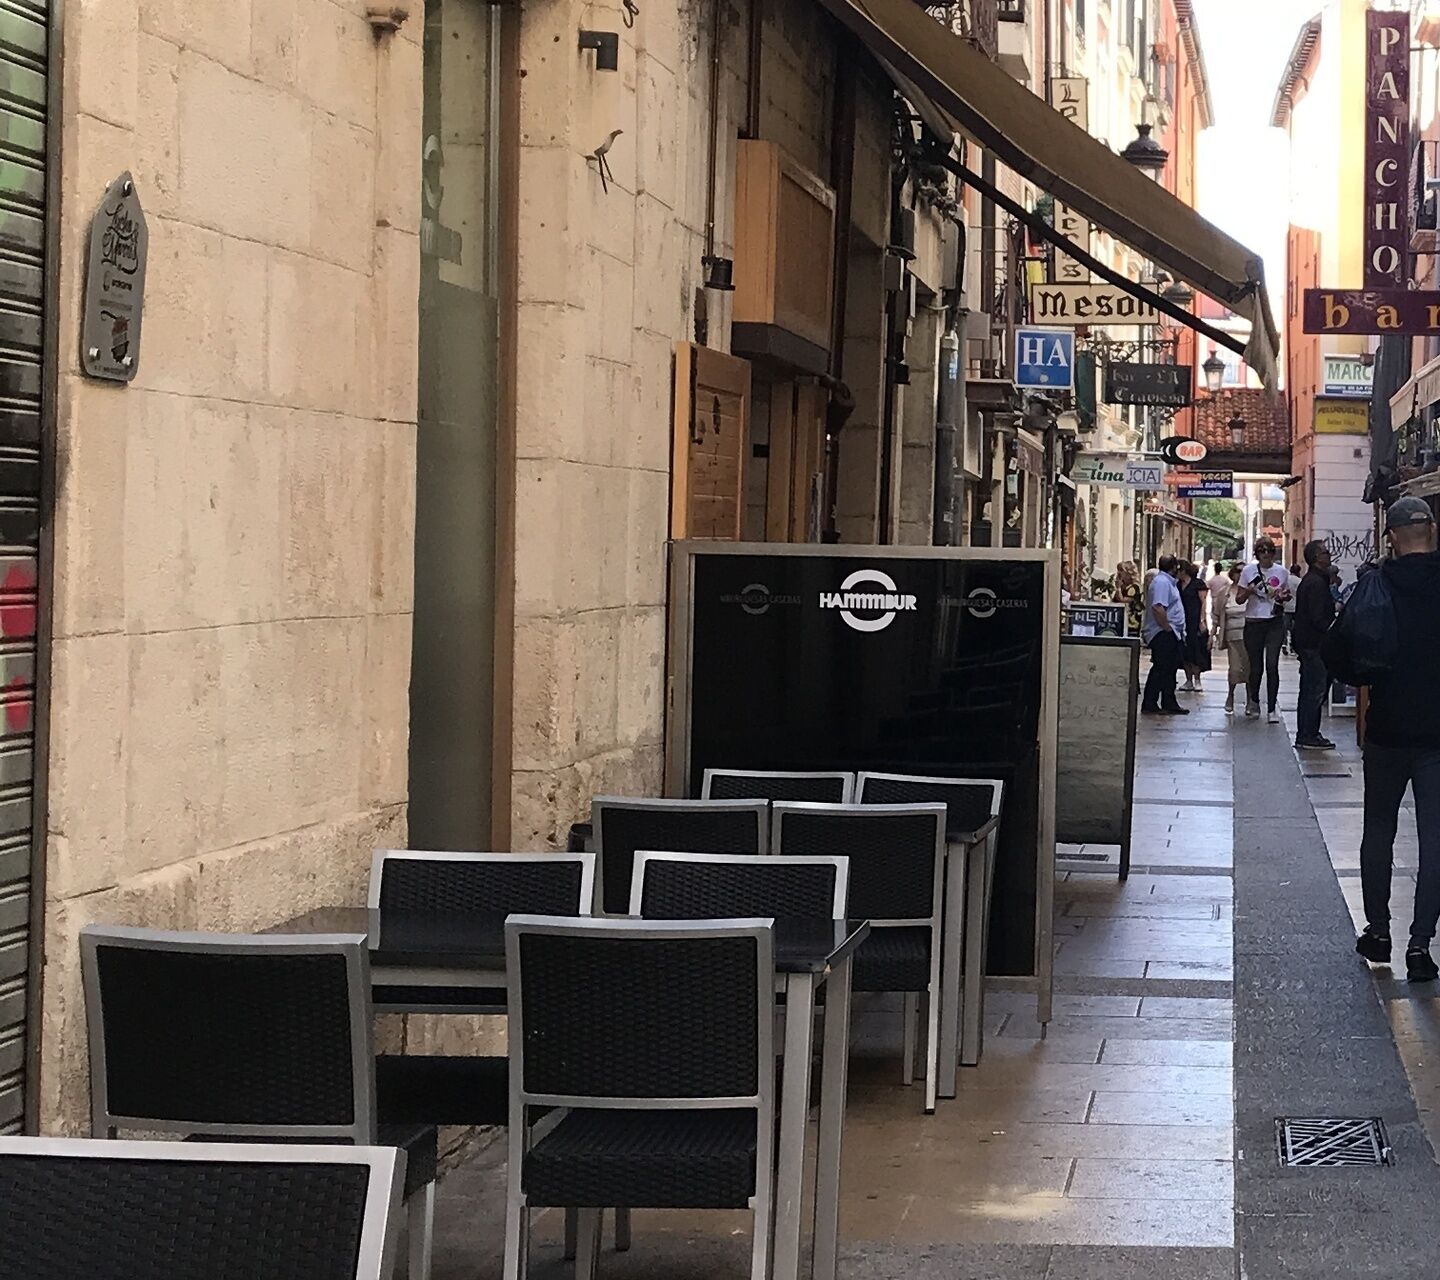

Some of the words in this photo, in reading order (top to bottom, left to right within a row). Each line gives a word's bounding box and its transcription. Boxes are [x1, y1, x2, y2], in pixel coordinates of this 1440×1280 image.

[1371, 26, 1401, 275] PANCHO
[1021, 334, 1067, 368] HA
[1179, 446, 1204, 457] BAR
[1144, 505, 1165, 513] PIZZA
